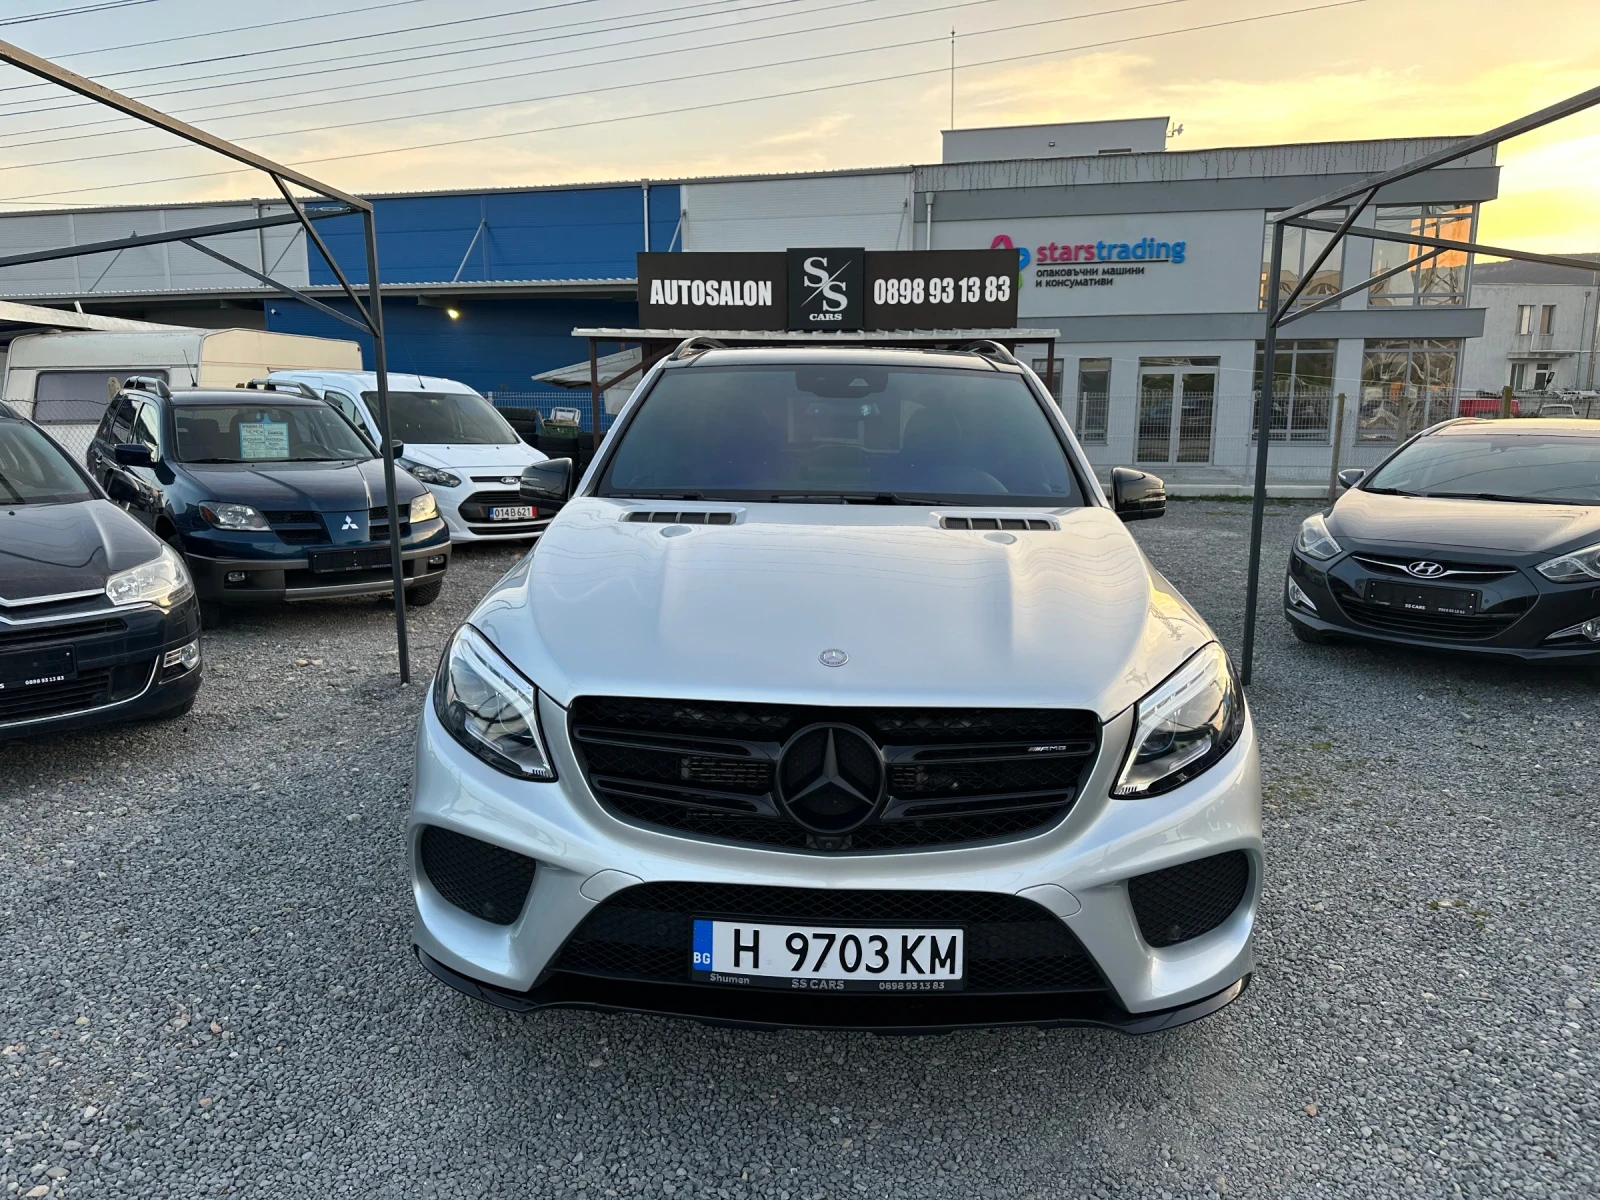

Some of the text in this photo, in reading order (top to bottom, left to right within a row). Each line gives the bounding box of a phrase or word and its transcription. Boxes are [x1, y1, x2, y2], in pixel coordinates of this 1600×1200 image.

[1036, 237, 1186, 264] starstrading
[1036, 266, 1145, 278] опаковъчни машини
[1035, 277, 1114, 289] и консумативи
[650, 279, 772, 306] AUTOSALON
[873, 275, 1011, 305] 0898 93 13 83
[809, 313, 842, 321] CARS
[733, 928, 957, 975] H 9703 KM
[693, 952, 711, 965] BG
[791, 978, 808, 989] SS
[809, 979, 844, 990] CARS
[879, 981, 904, 990] 0898
[905, 982, 918, 990] 93
[919, 981, 931, 990] 13
[932, 981, 945, 990] 83
